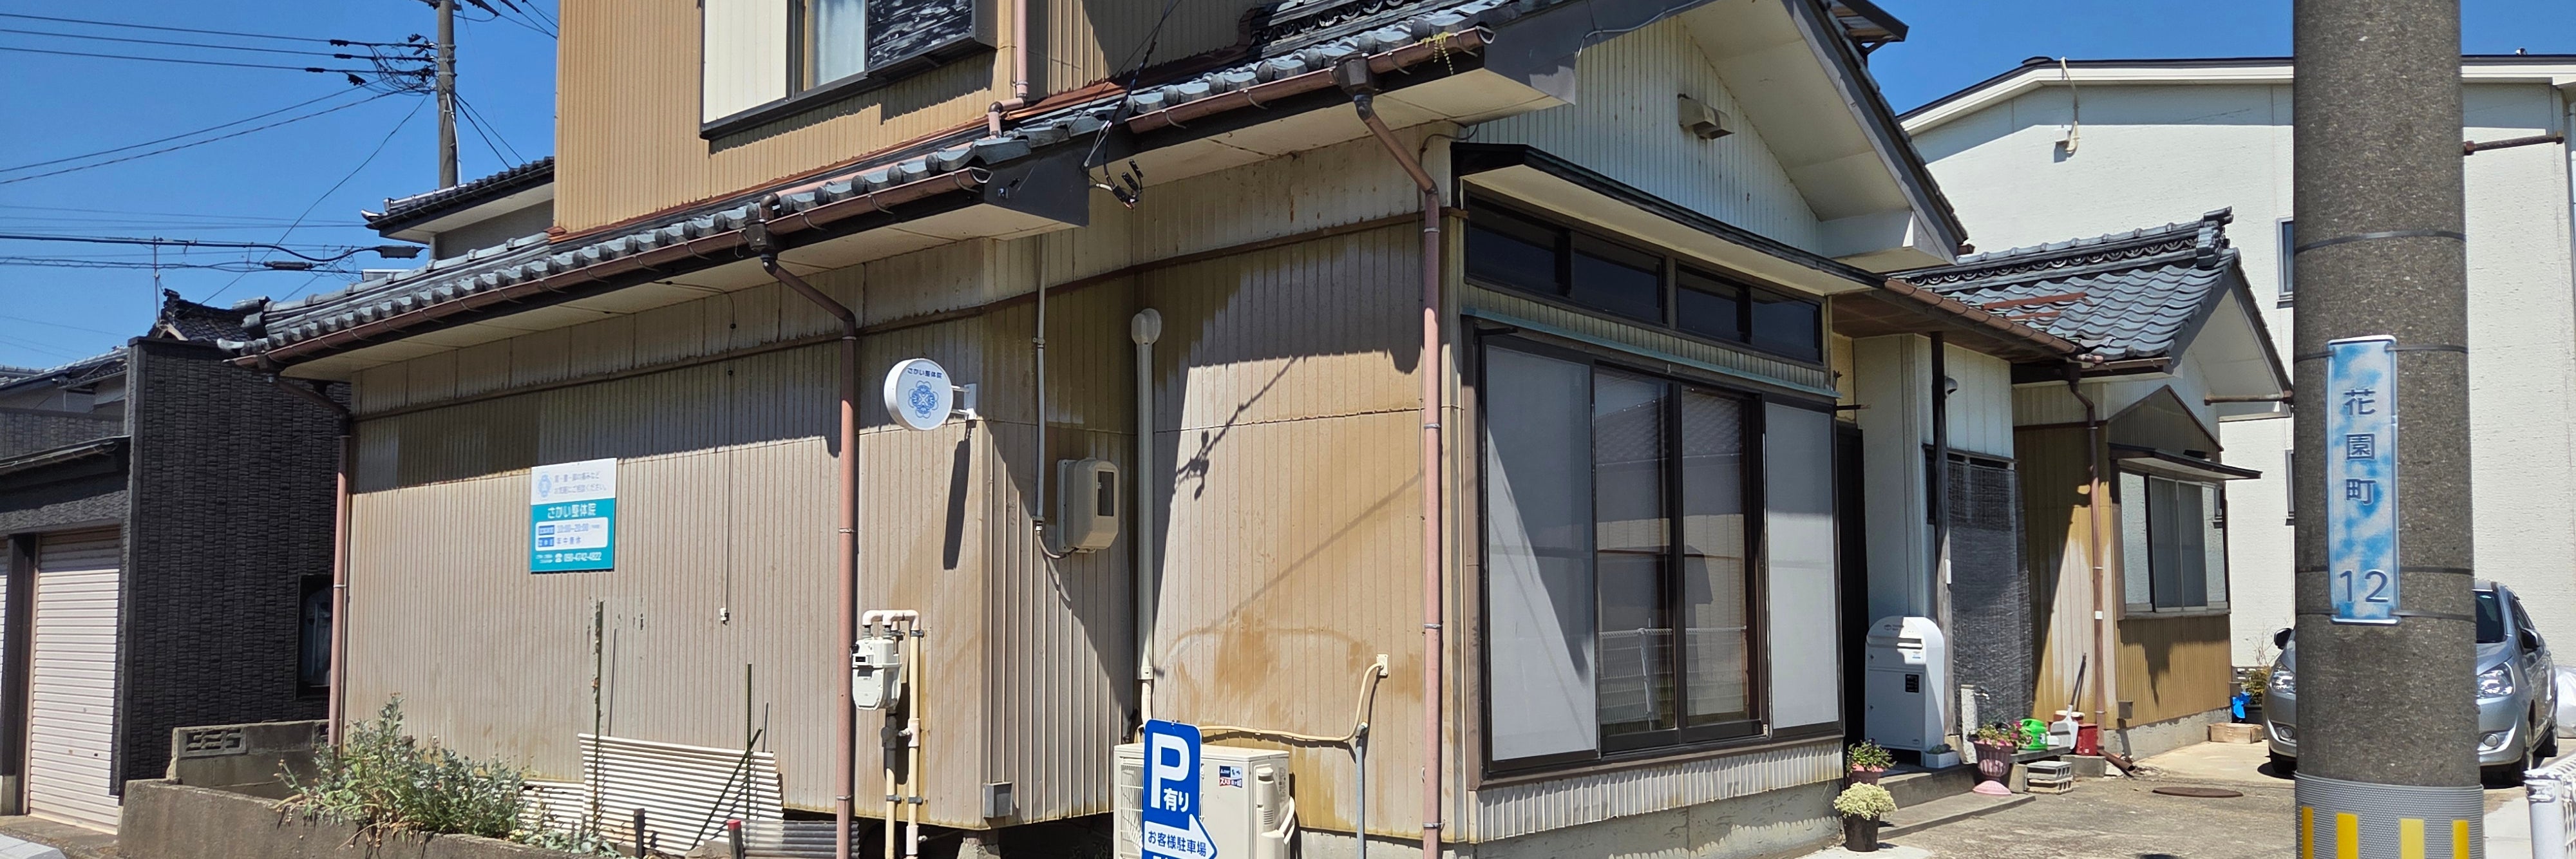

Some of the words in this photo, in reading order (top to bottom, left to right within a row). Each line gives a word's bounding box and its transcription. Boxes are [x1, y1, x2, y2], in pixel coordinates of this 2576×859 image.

[2343, 388, 2376, 504] 花園町
[547, 503, 597, 519] さかい整体院
[2339, 569, 2390, 603] 12
[1150, 732, 1190, 809] P
[1163, 788, 1189, 813] 有り
[1148, 831, 1207, 857] お客様駐車場
